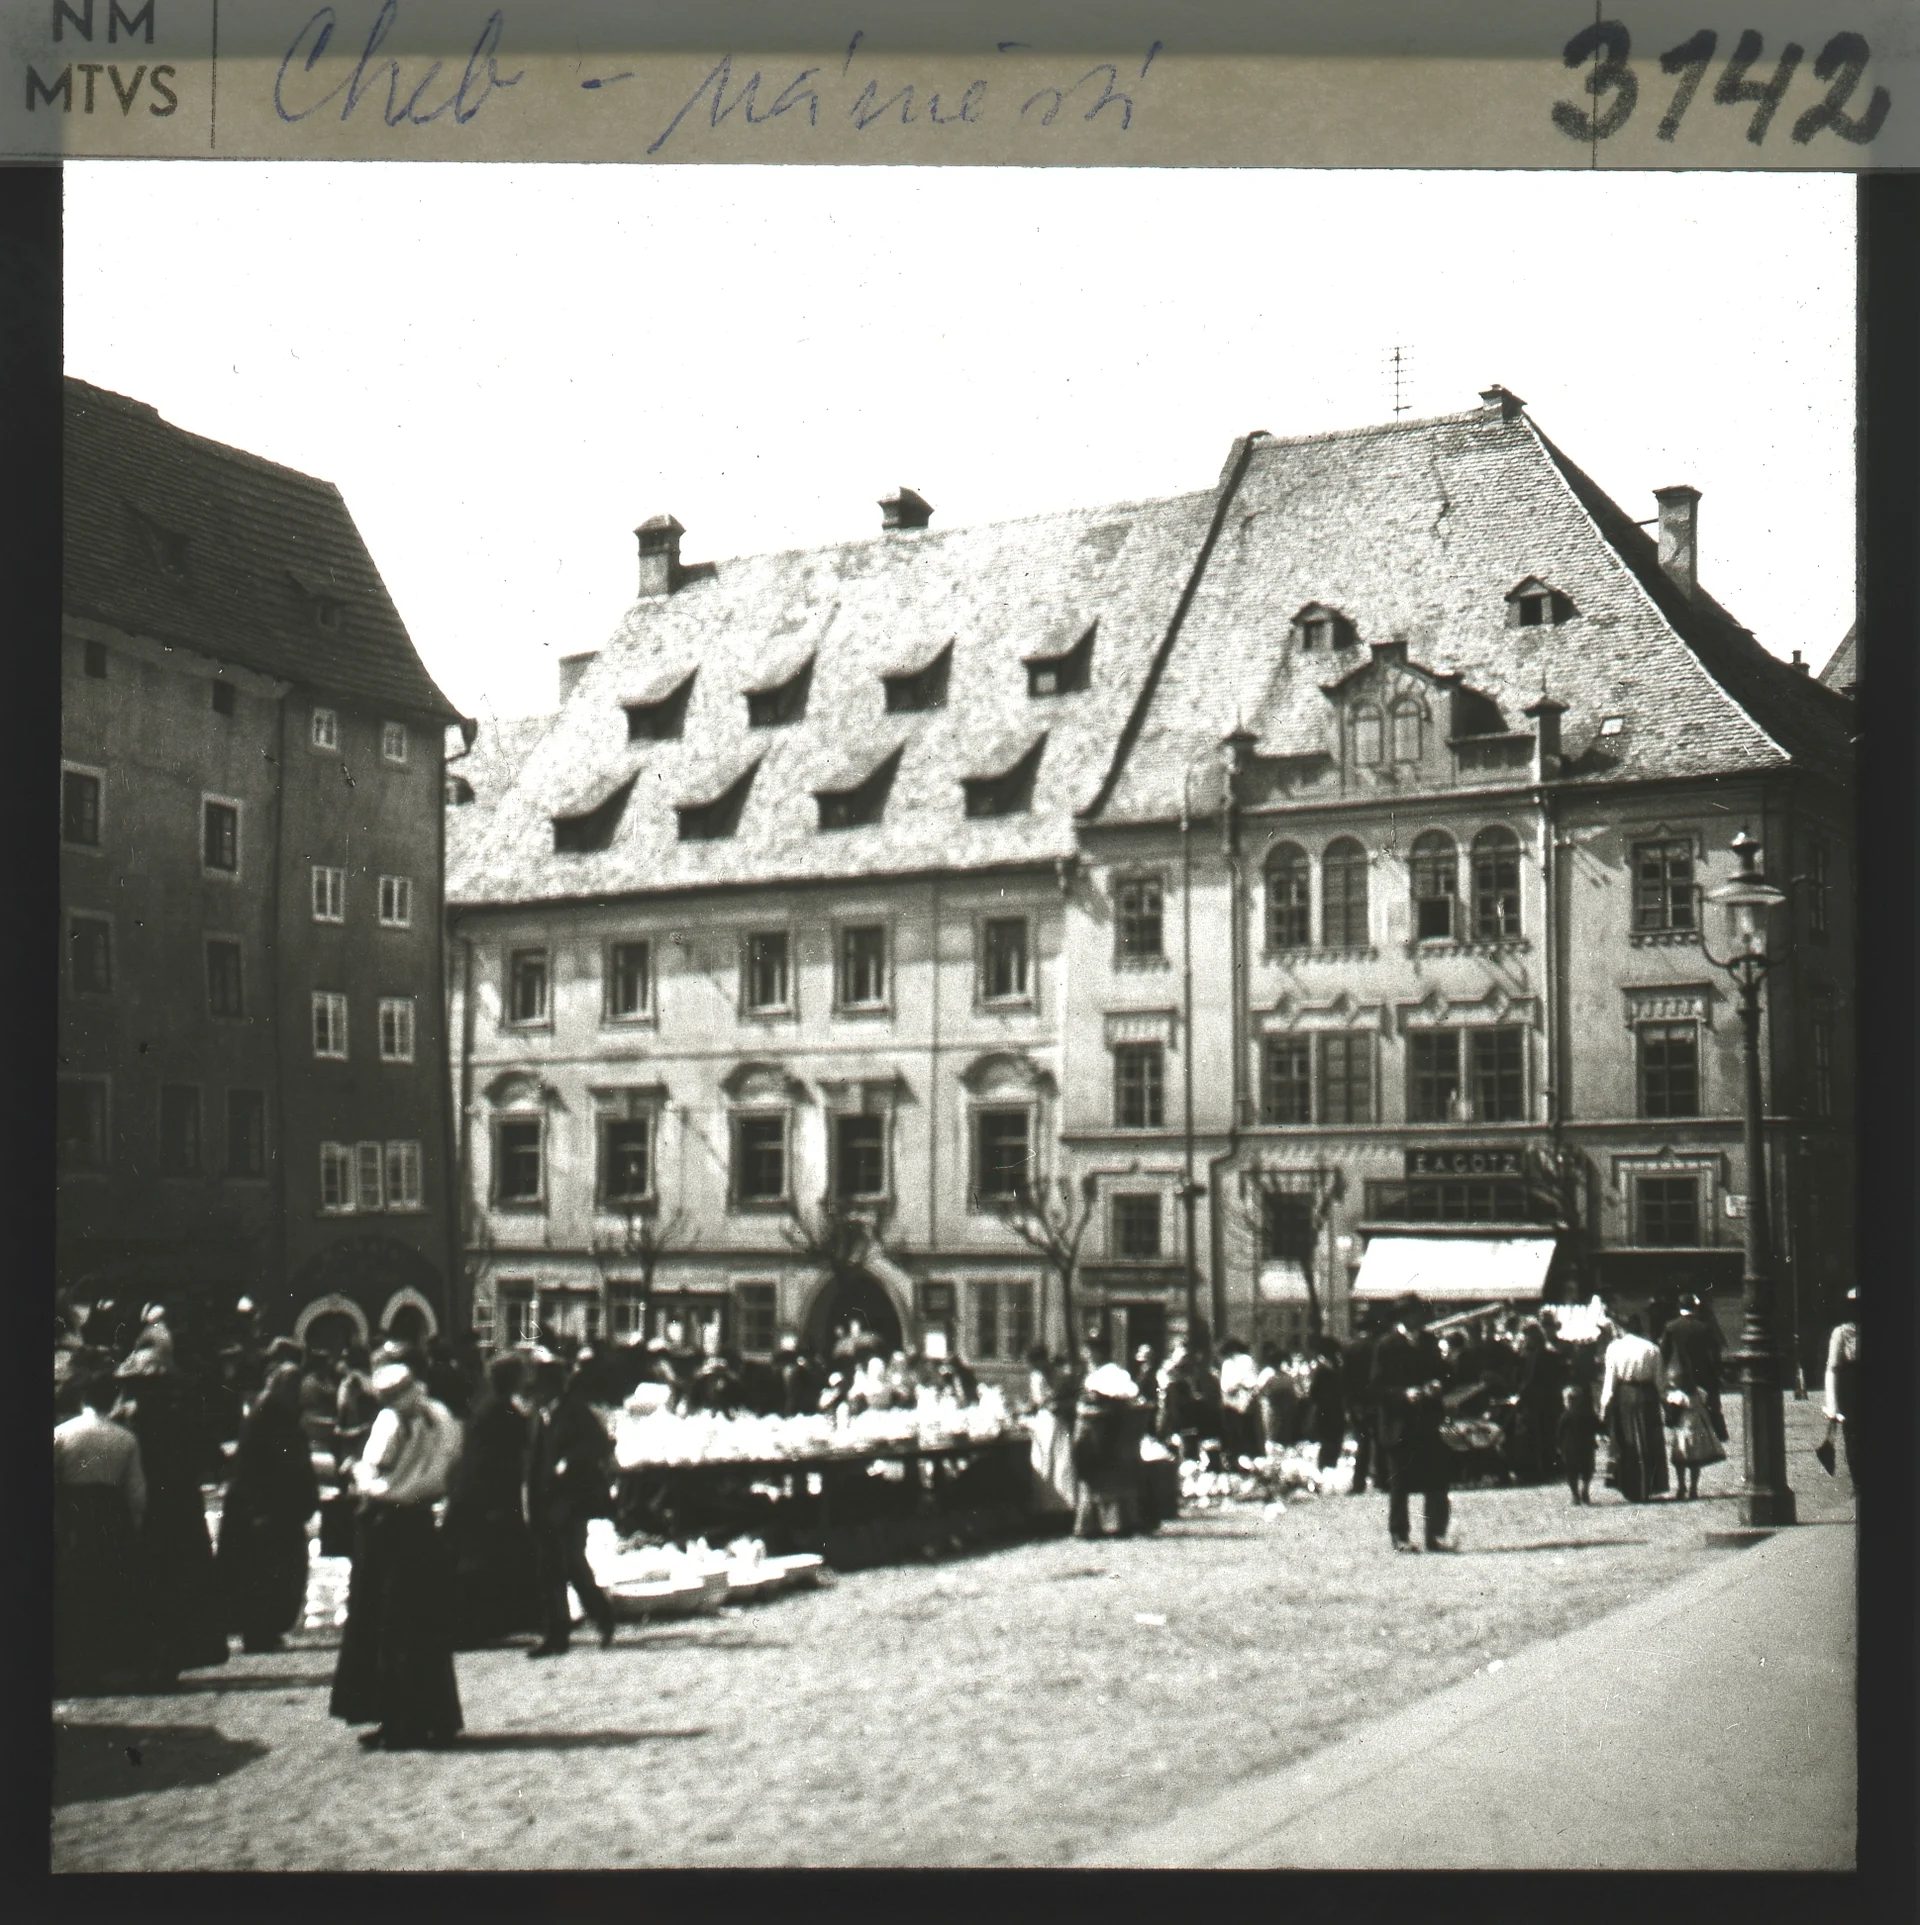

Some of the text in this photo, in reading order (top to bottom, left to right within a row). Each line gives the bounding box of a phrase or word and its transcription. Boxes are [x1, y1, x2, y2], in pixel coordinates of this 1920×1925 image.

[52, 0, 155, 44] NM
[275, 0, 525, 126] Cheb
[25, 63, 178, 117] MTVS
[1551, 19, 1892, 146] 3142
